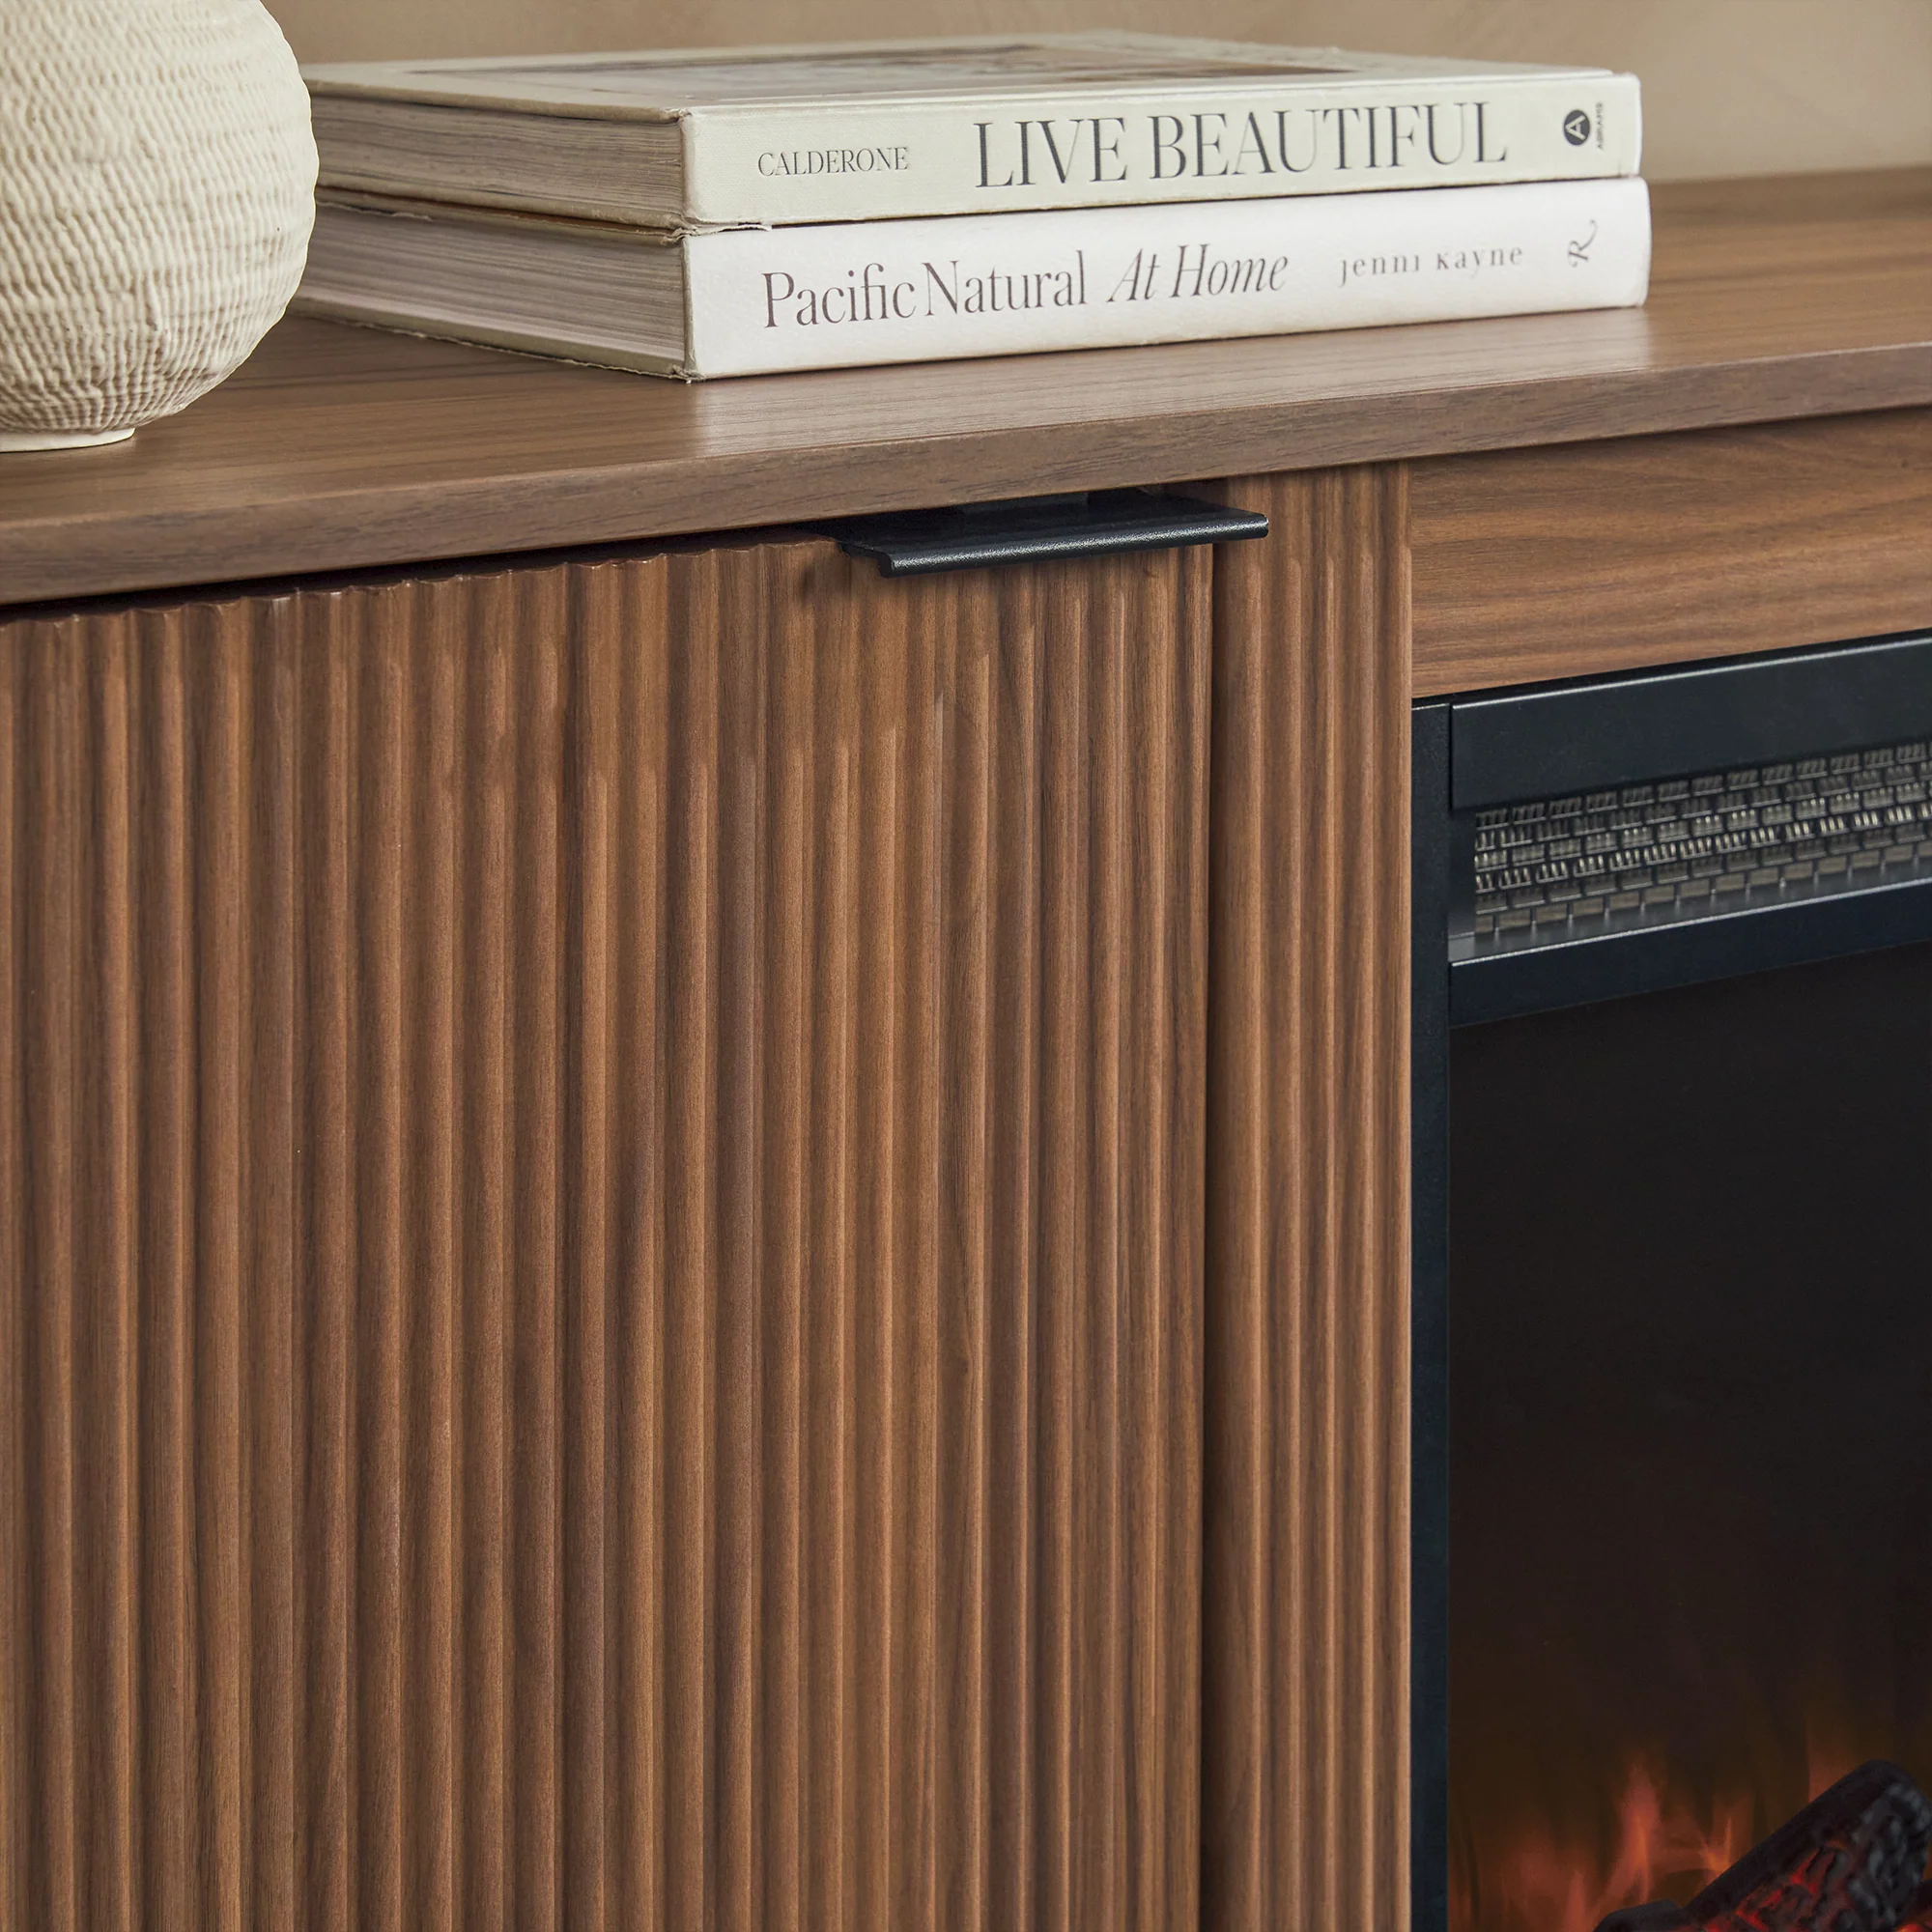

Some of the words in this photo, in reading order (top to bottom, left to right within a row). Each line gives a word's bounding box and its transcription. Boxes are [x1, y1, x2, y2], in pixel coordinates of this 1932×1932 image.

[758, 147, 908, 176] CALDERONE
[973, 118, 1127, 187] LIVE
[1148, 101, 1507, 180] BEAUTIFUL
[761, 263, 916, 328] Pacific
[922, 250, 1088, 317] Natural
[1106, 248, 1161, 303] At
[1169, 243, 1289, 298] Home
[1337, 254, 1420, 289] jenni
